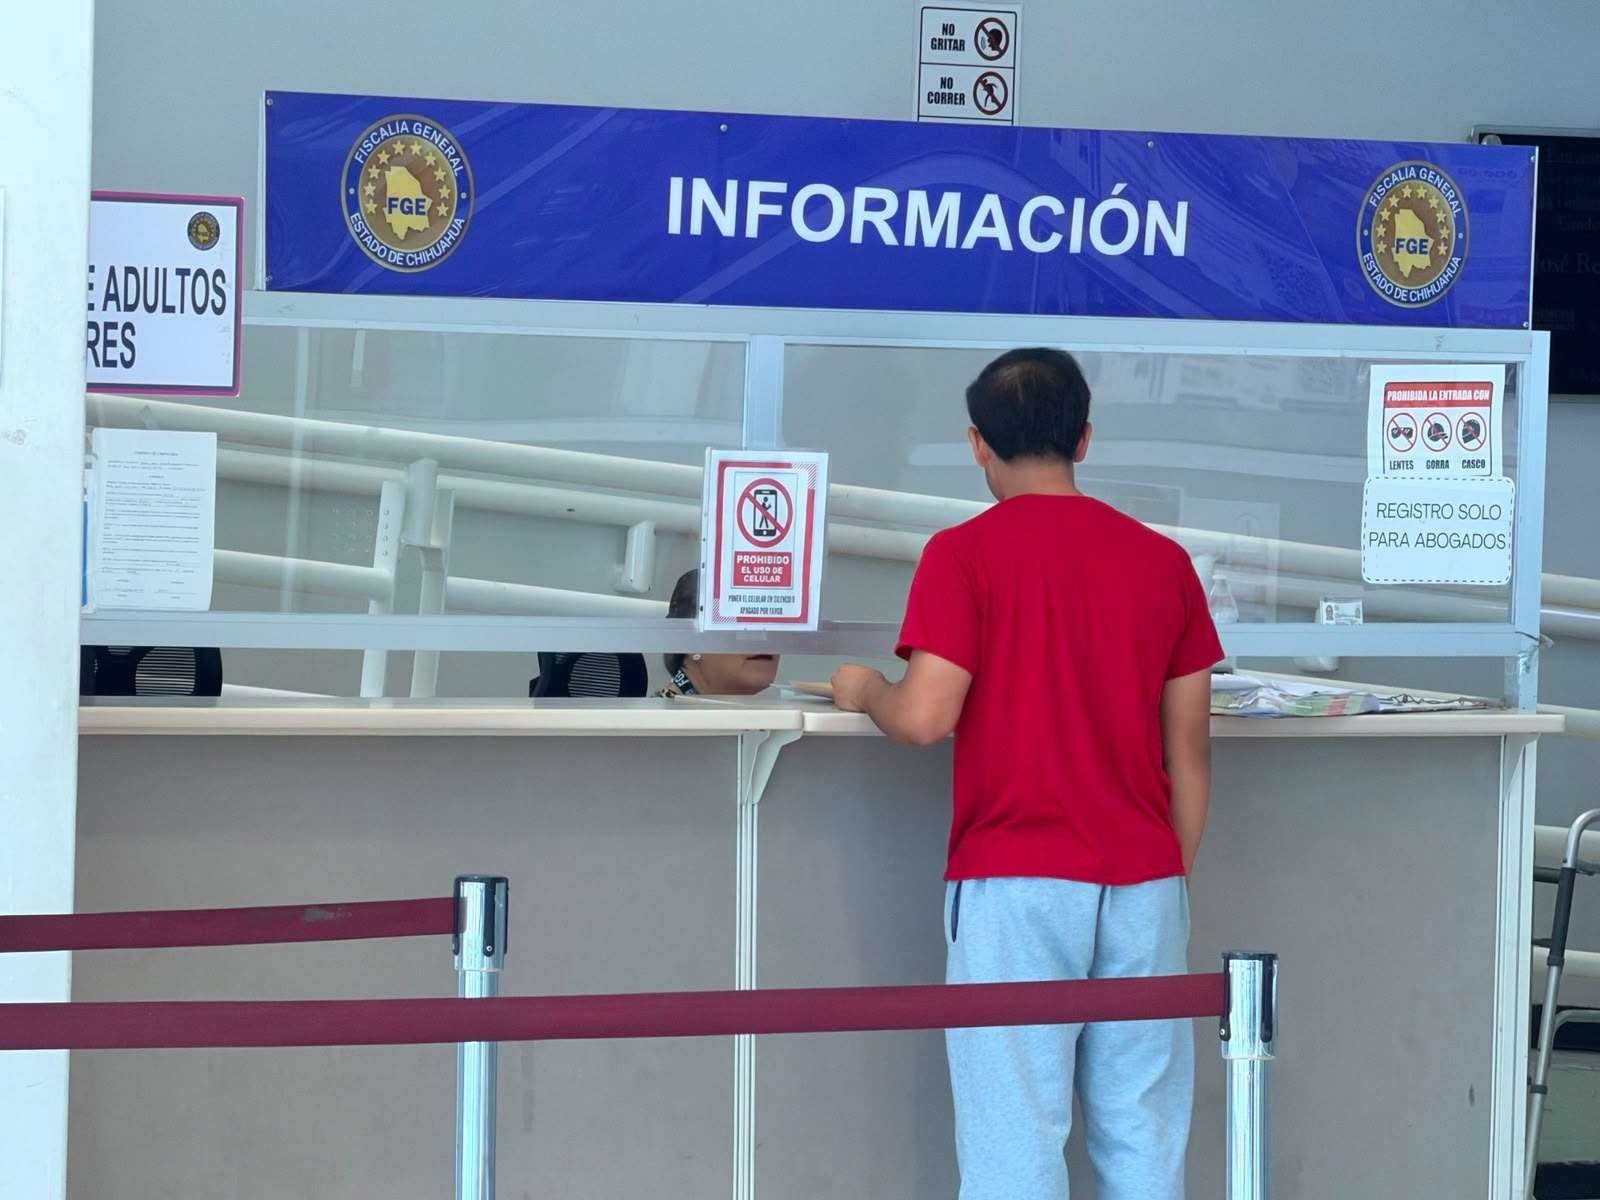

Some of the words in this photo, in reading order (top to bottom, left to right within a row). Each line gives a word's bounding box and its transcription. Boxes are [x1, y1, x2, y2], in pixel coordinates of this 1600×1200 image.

[942, 23, 955, 36] NO
[930, 37, 965, 52] GRITAR
[940, 76, 953, 89] NO
[927, 91, 965, 106] CORRER
[413, 121, 464, 177] GENERAL
[1419, 167, 1462, 218] GENERAL
[387, 197, 426, 216] FGE
[667, 176, 1189, 257] INFORMACIÓN
[350, 212, 387, 258] ESTADO
[388, 250, 404, 265] DE
[406, 217, 465, 266] CHIHUAHUA
[1395, 238, 1429, 255] FGE
[1363, 252, 1393, 295] ESTADO
[1394, 288, 1408, 301] DE
[1409, 256, 1462, 302] CHIHUAHUA
[102, 264, 227, 316] ADULTOS
[1428, 390, 1438, 401] LA
[1440, 389, 1473, 401] ENTRADA
[1473, 389, 1490, 400] CON
[1389, 460, 1414, 470] LENTES
[1426, 459, 1450, 469] GORRA
[1462, 459, 1486, 469] CASCO
[1376, 502, 1454, 520] REGISTRO
[1458, 503, 1502, 520] SOLO
[1368, 532, 1410, 548] PARA
[1414, 532, 1506, 549] ABOGADOS
[736, 555, 790, 565] PROHIBIDO
[741, 566, 752, 574] EL
[753, 566, 771, 574] USO
[772, 566, 783, 574] DE
[743, 575, 781, 583] CELULAR
